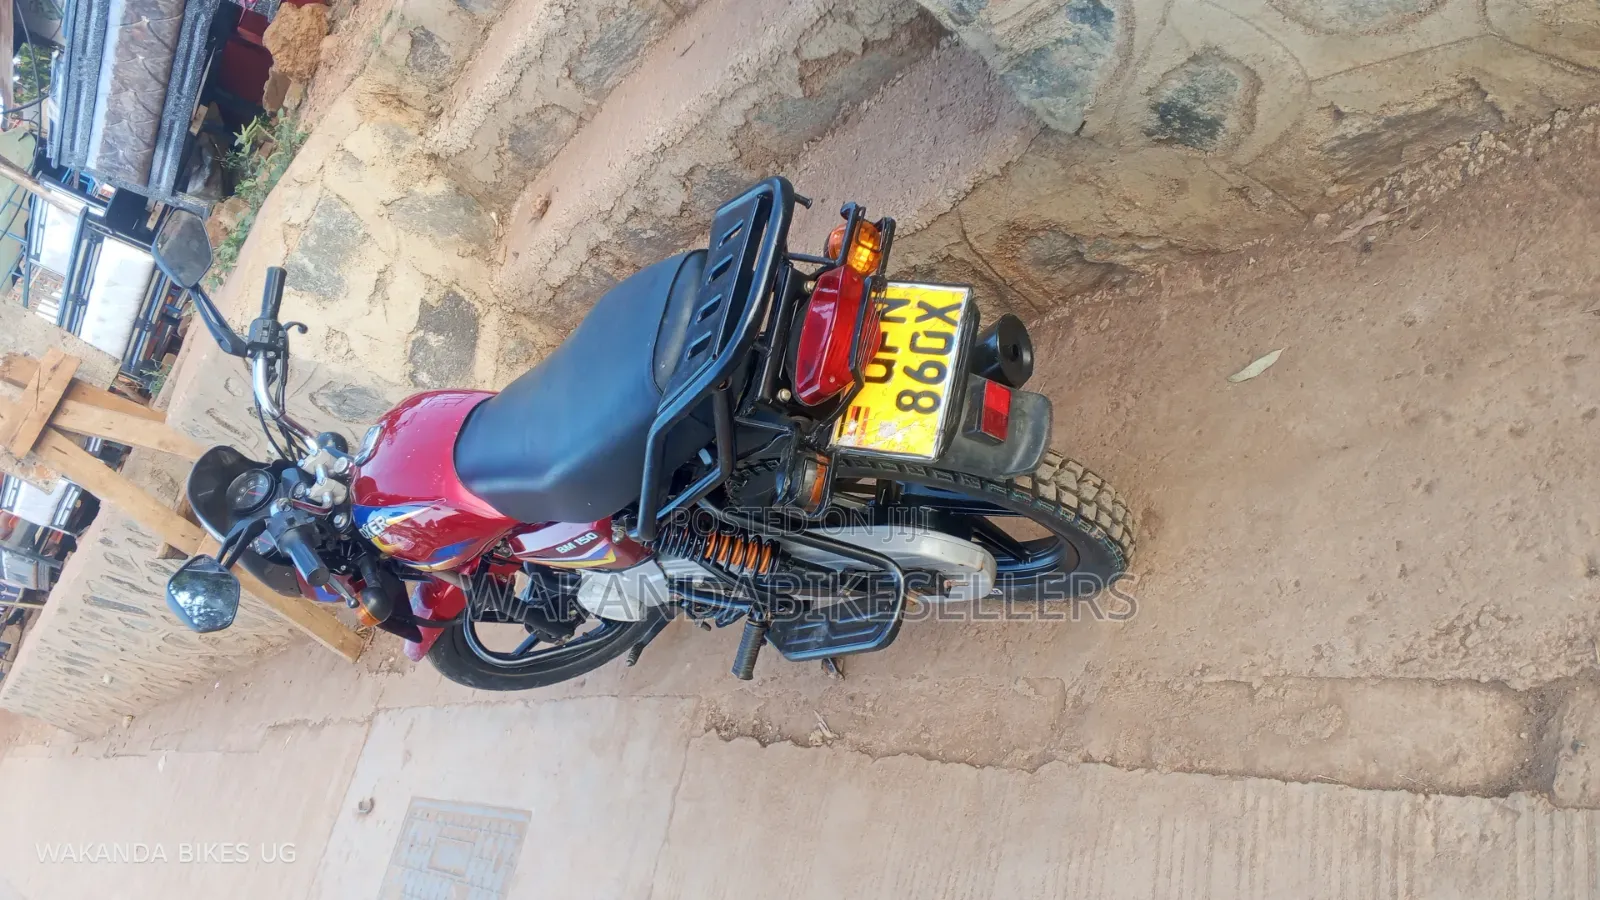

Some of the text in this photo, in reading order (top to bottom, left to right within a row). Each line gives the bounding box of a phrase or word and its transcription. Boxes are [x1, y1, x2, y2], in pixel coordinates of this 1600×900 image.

[358, 516, 388, 539] OXER
[555, 532, 598, 554] BM 150
